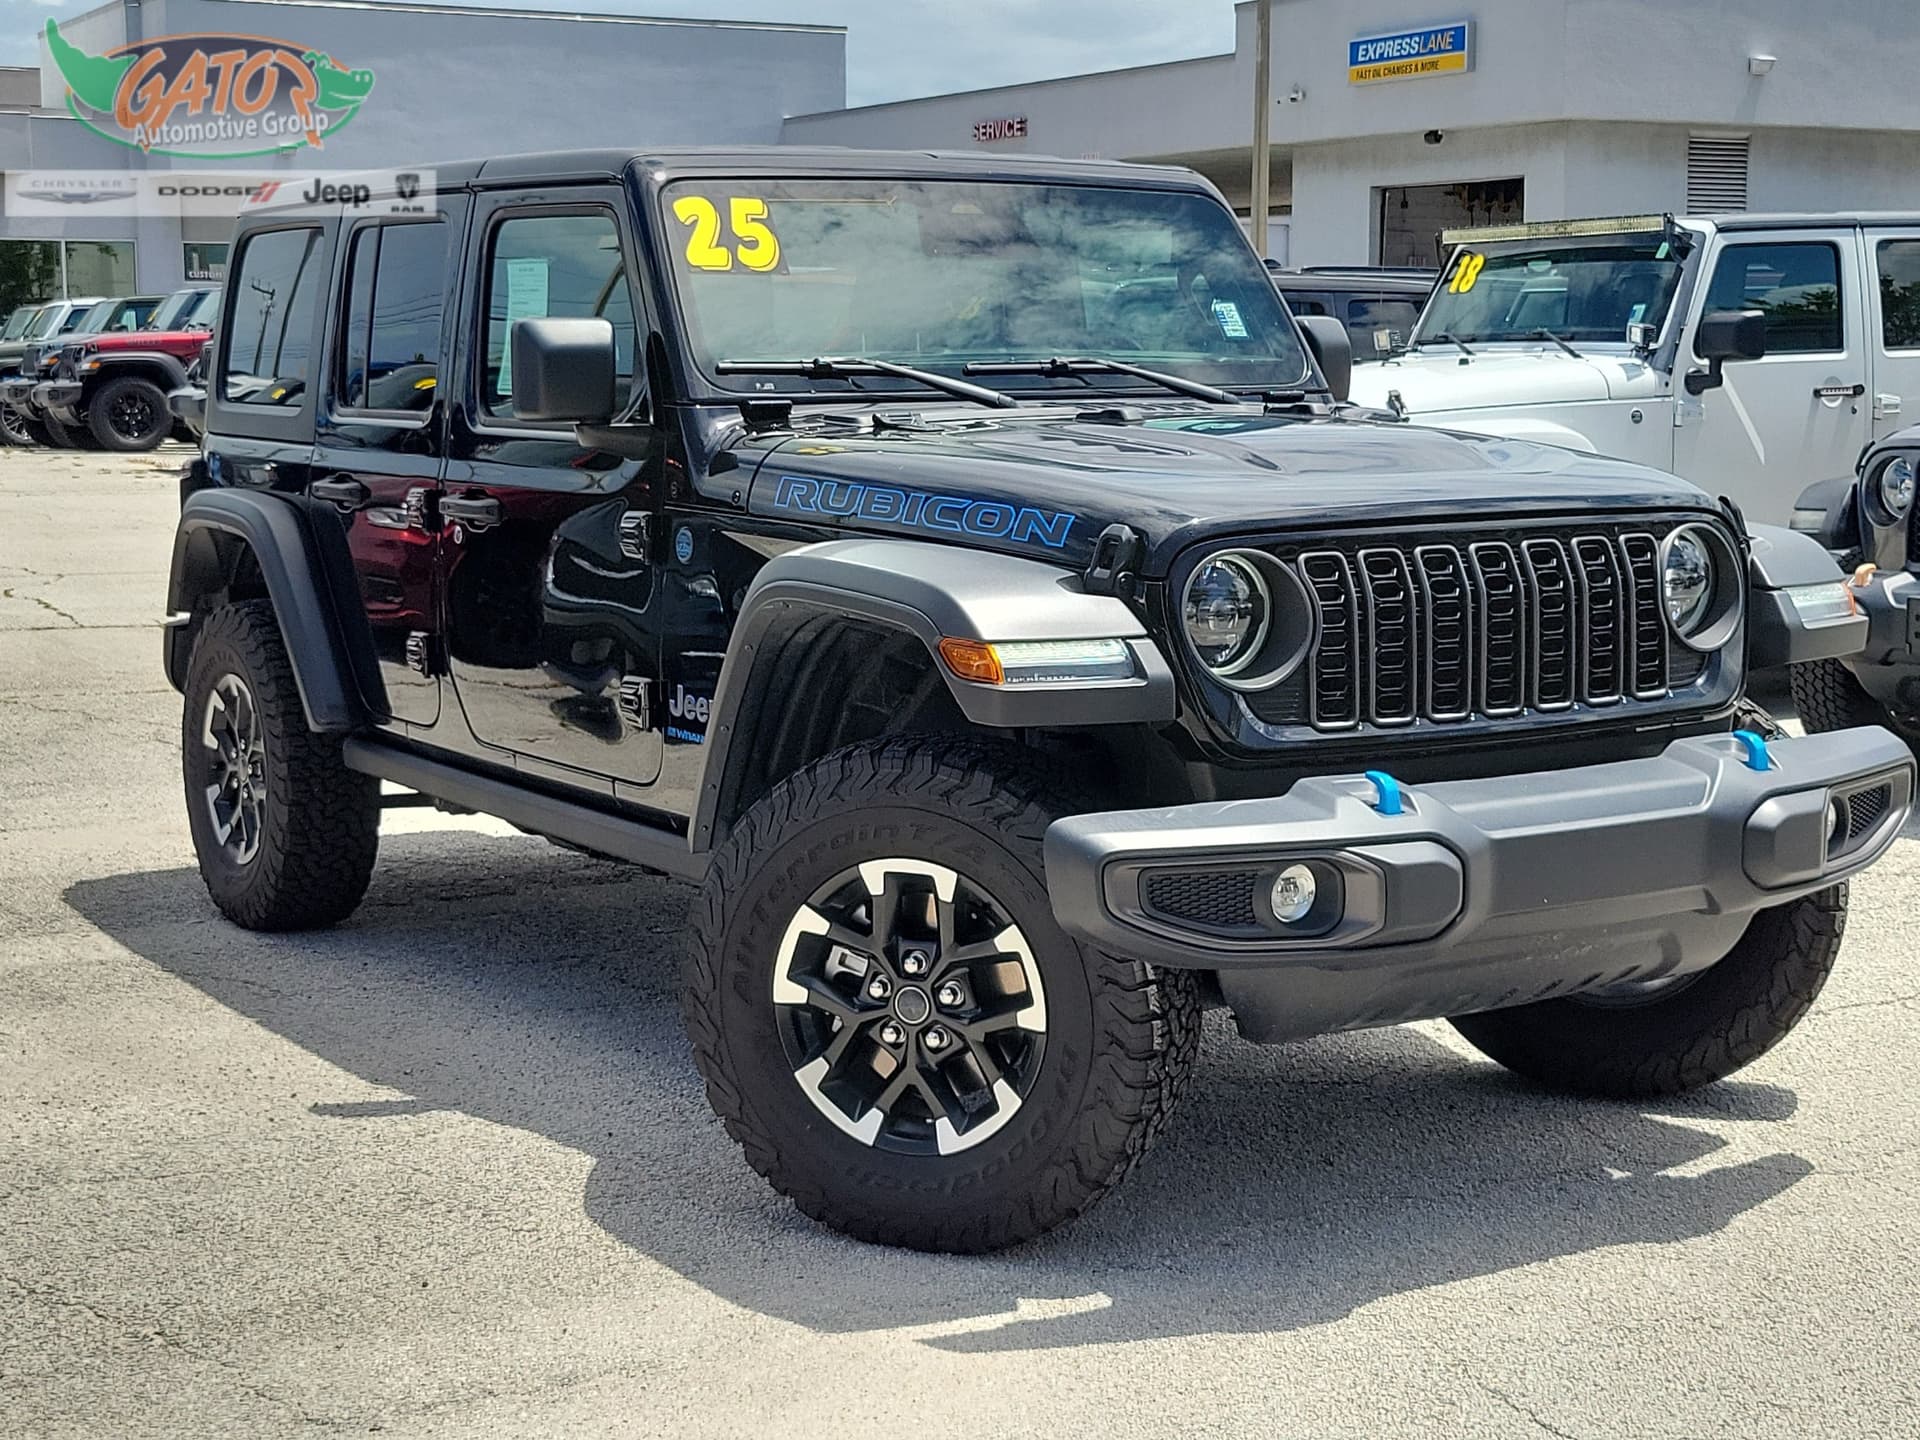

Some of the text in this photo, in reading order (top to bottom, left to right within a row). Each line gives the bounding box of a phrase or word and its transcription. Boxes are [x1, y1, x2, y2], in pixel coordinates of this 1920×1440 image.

[1355, 69, 1372, 81] FAST
[1372, 67, 1382, 78] OIL
[1383, 64, 1413, 77] CHANGES
[1420, 60, 1440, 72] MORE
[973, 118, 1024, 142] SERVICE
[672, 196, 780, 273] 25
[188, 271, 224, 279] CUSTOM
[1448, 253, 1485, 294] 18
[775, 475, 1076, 548] RUBICON
[669, 683, 714, 723] Jee
